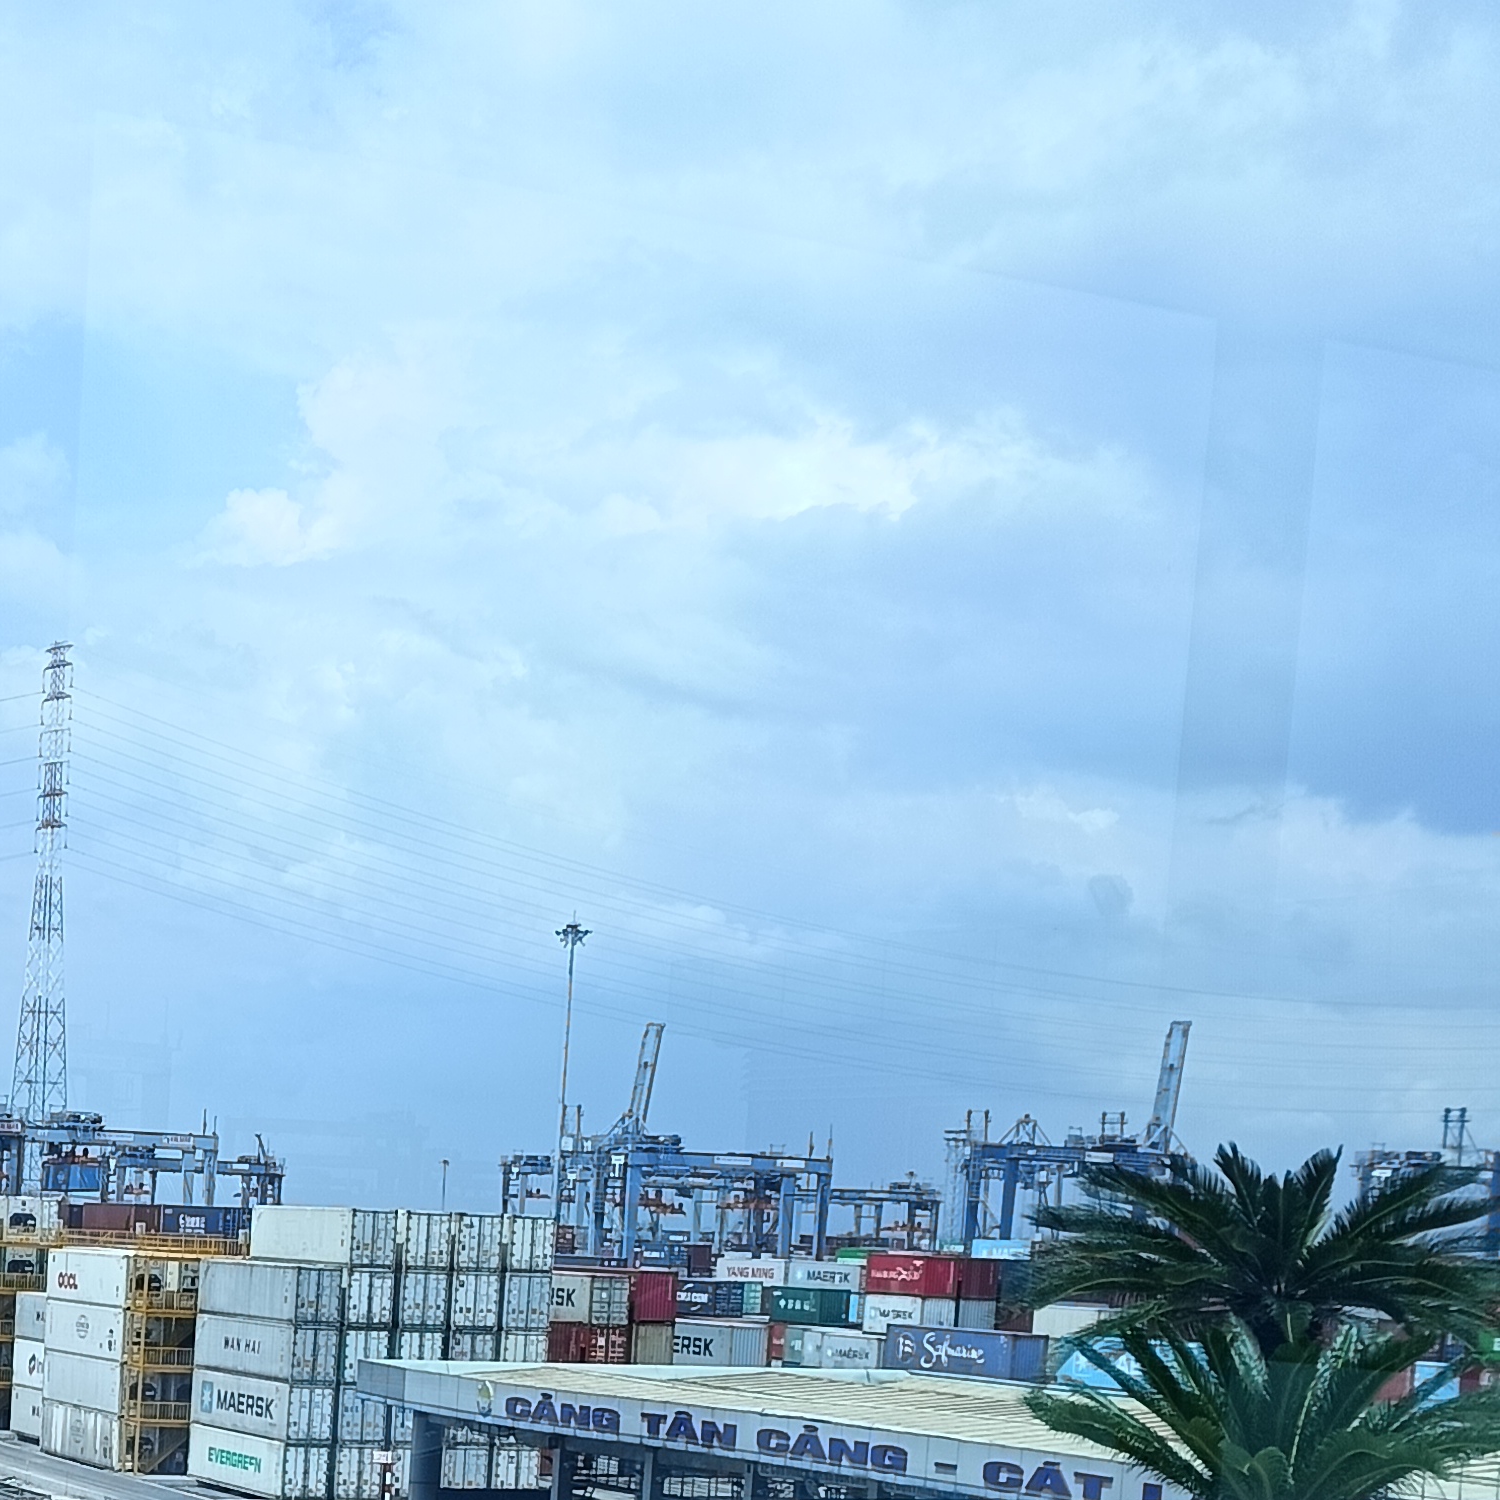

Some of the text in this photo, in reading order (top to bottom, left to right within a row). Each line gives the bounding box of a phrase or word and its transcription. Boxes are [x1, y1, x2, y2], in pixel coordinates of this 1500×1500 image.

[58, 1271, 78, 1289] OOCL
[726, 1266, 775, 1279] YANG MING
[224, 1336, 261, 1354] WAN HAI
[216, 1389, 275, 1420] MAERSK
[505, 1393, 620, 1436] CẢNG
[641, 1411, 738, 1451] TÂN
[757, 1425, 908, 1475] CẢNG
[208, 1446, 262, 1473] EVERGREEN
